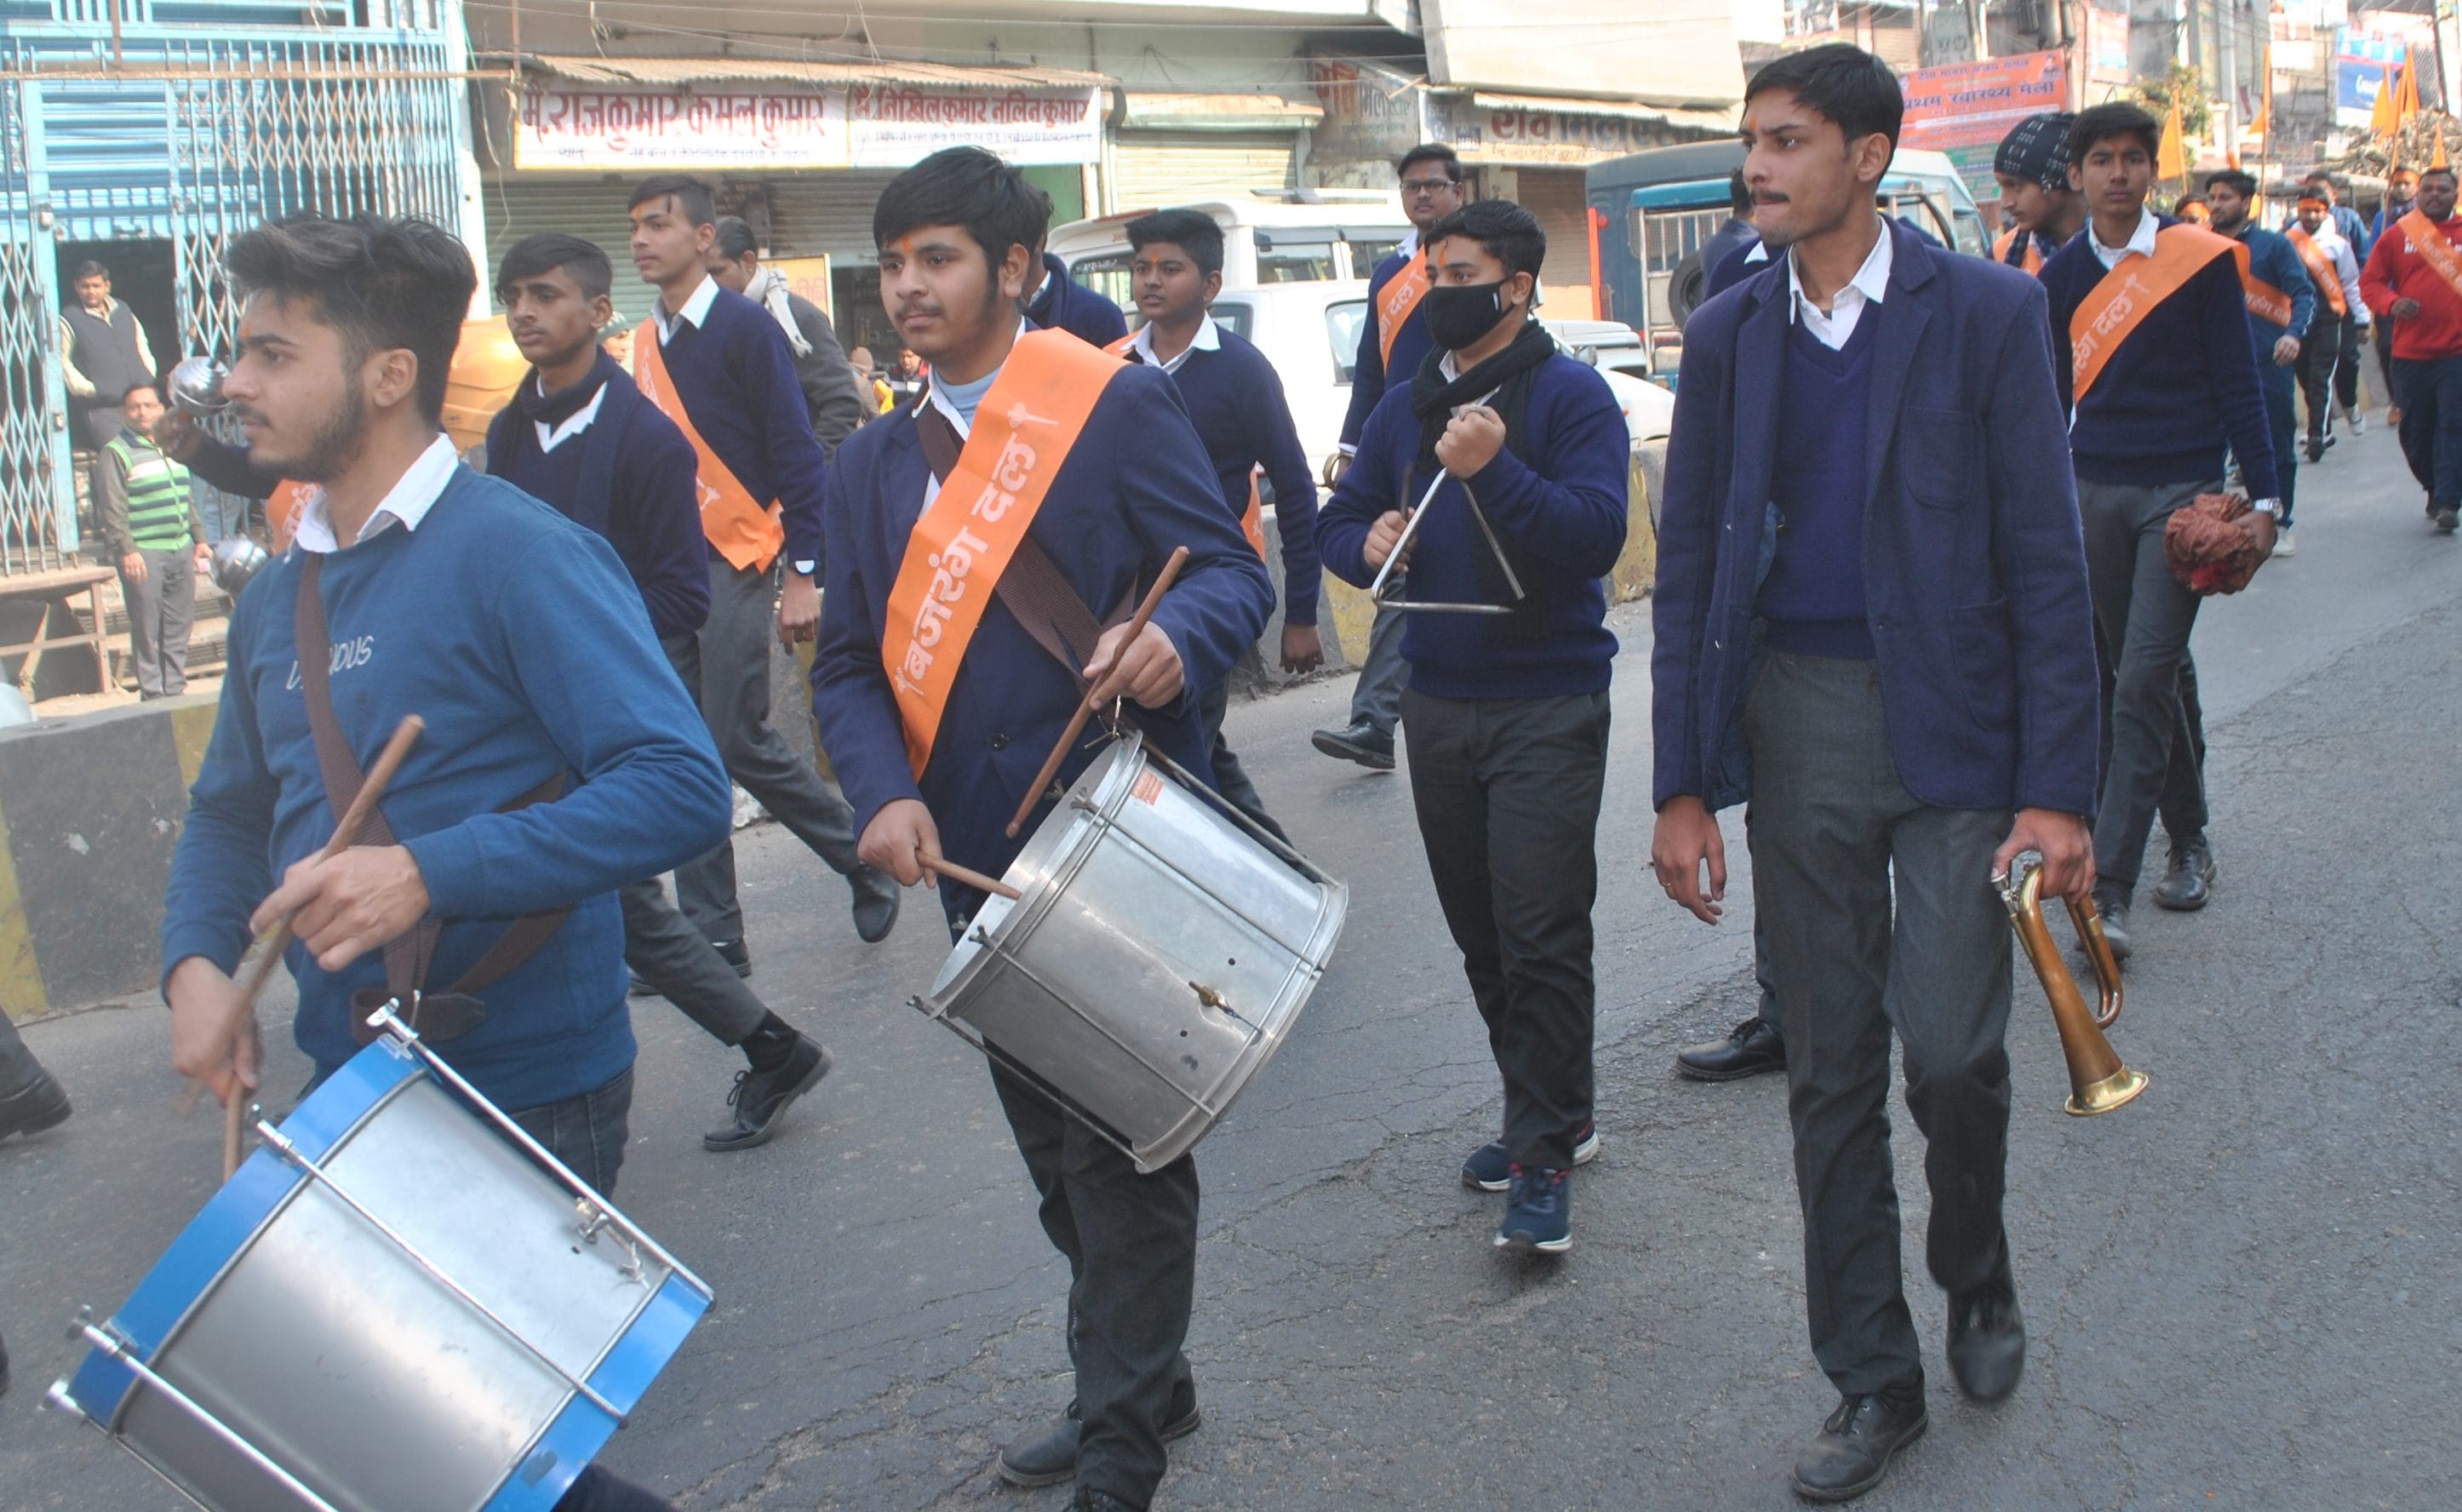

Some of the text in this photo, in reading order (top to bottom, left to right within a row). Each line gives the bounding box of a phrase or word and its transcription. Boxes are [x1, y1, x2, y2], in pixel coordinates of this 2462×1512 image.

[1386, 284, 1415, 316] दल
[2092, 289, 2134, 335] दल
[904, 432, 1036, 680] बजरंग दल
